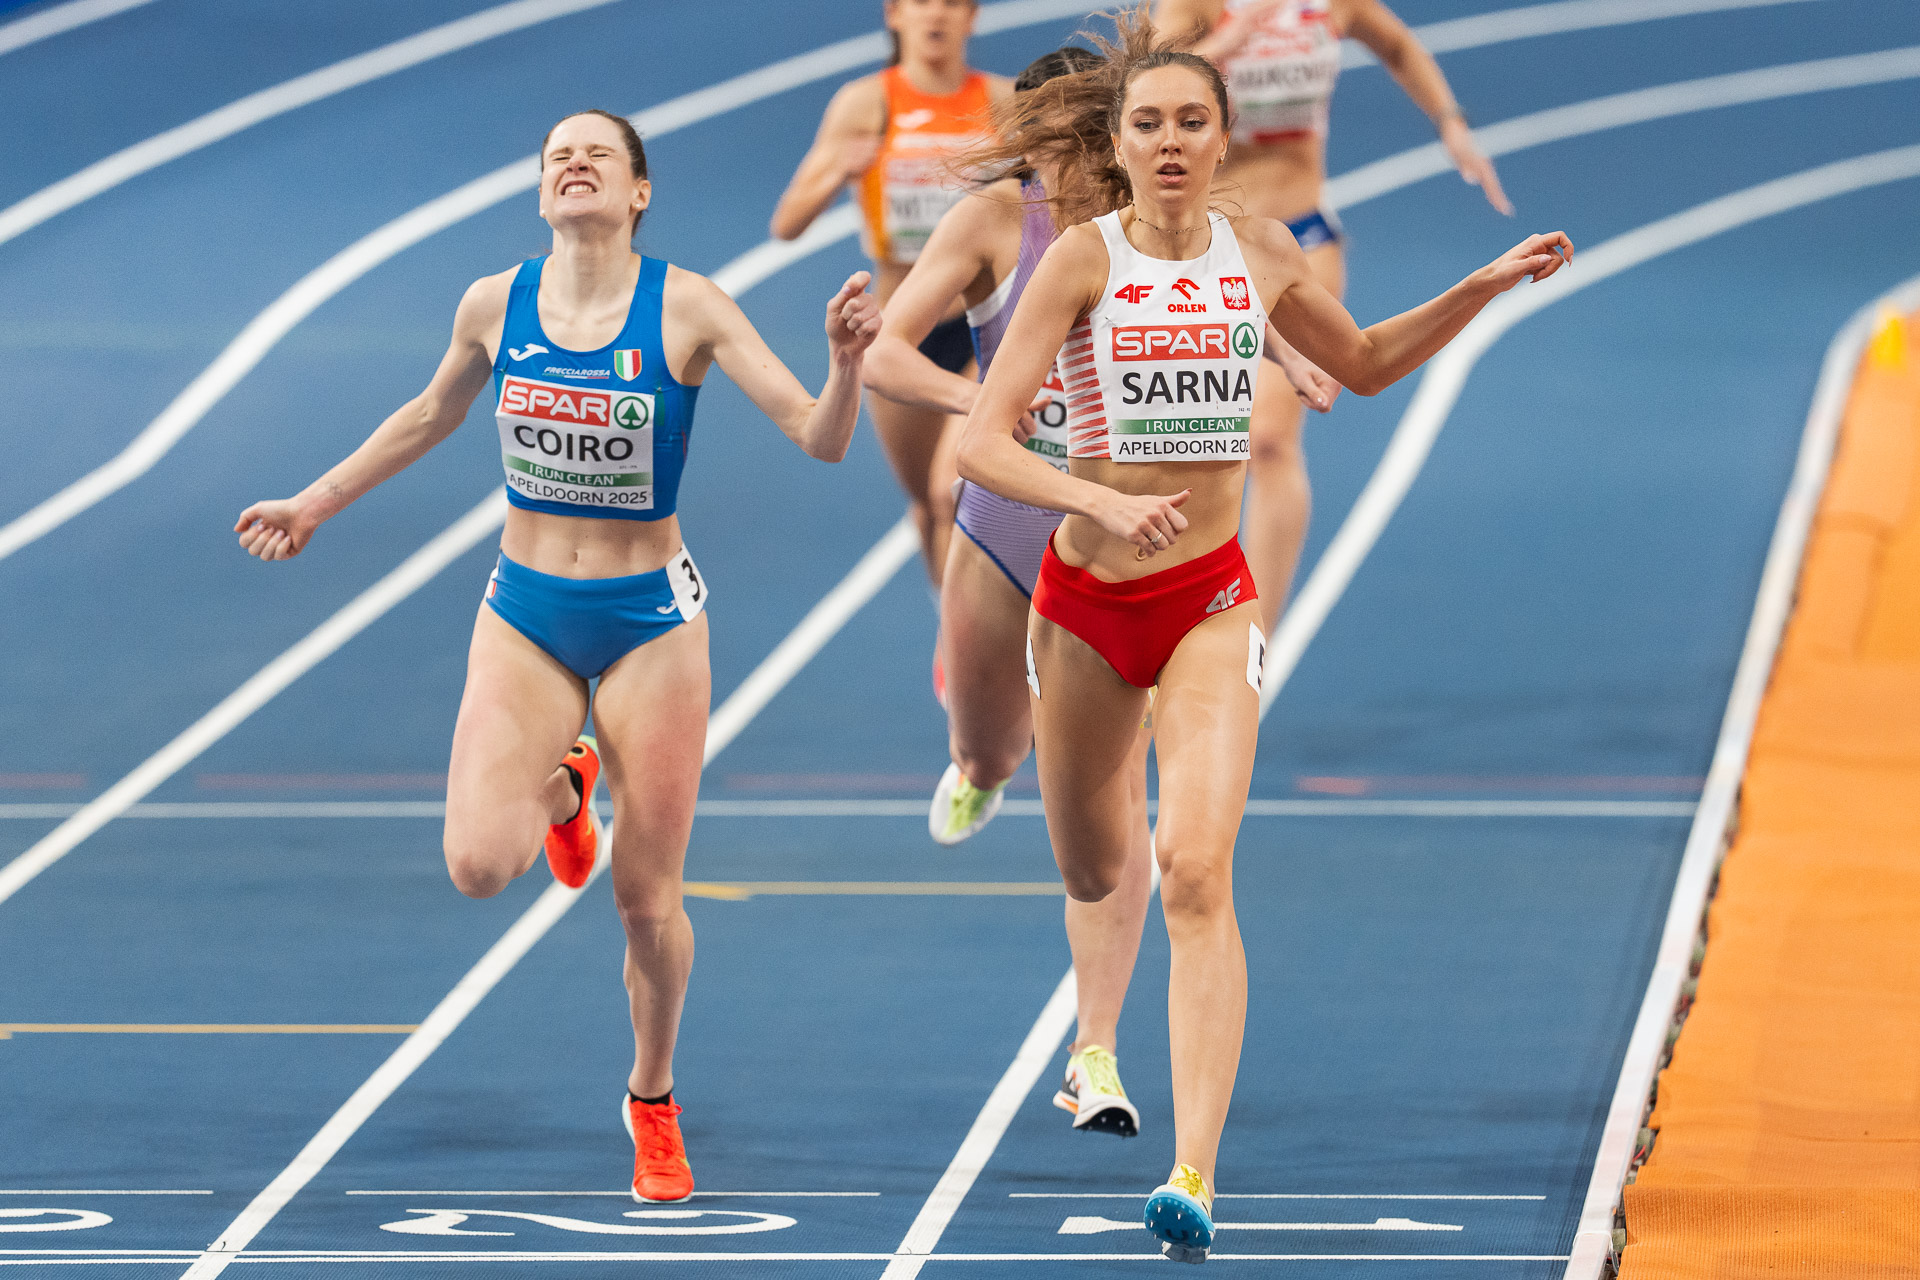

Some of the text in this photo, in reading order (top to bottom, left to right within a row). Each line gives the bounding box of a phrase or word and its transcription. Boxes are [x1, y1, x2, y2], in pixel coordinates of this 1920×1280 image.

[1114, 283, 1154, 304] 4F
[1167, 303, 1207, 313] ORLEN
[1115, 328, 1227, 356] SPAR
[544, 366, 611, 376] FRECCIAROSSA
[1122, 368, 1252, 405] SARNA
[504, 385, 608, 422] SPAR
[1146, 420, 1150, 432] I
[1153, 419, 1186, 432] RUN
[514, 424, 634, 462] COIRO
[1118, 439, 1227, 456] APELDOORN
[529, 463, 535, 474] I
[535, 464, 565, 481] RUN
[509, 473, 648, 505] APELDOORN 2025
[681, 558, 701, 602] 3
[1205, 577, 1241, 614] 4F
